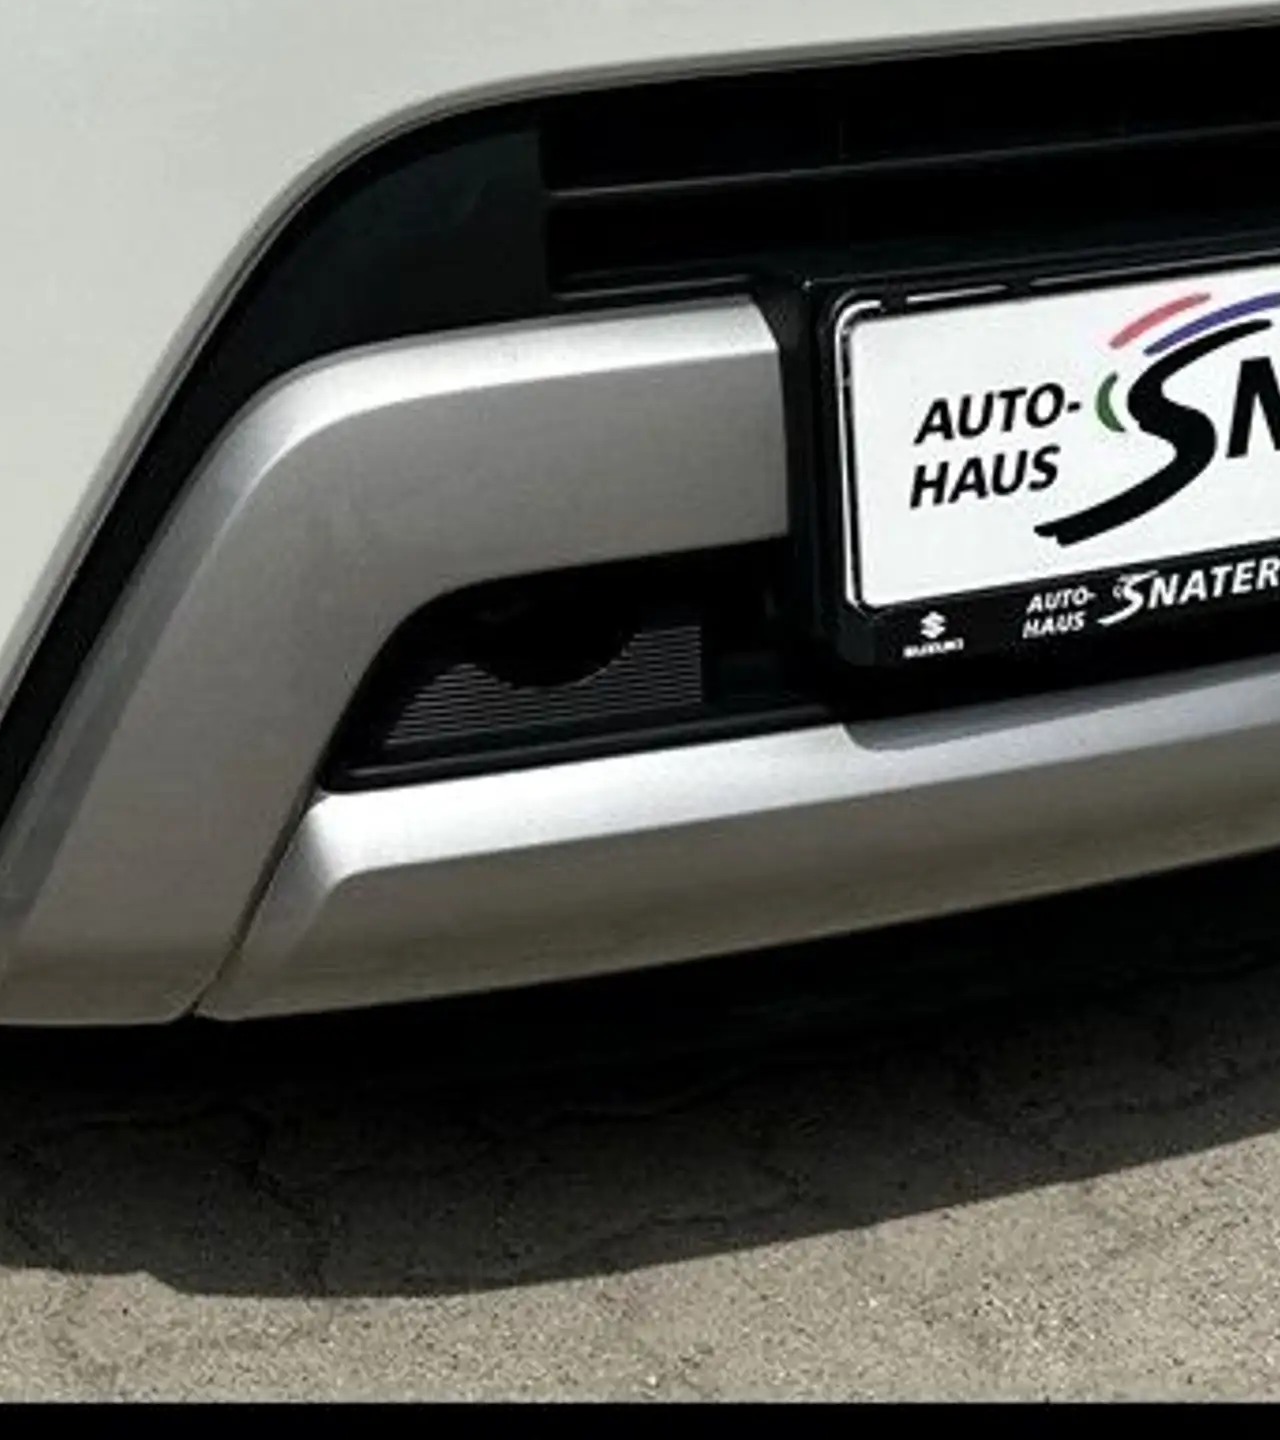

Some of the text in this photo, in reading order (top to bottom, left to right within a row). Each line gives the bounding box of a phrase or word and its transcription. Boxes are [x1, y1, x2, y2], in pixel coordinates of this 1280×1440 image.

[913, 382, 1081, 445] AUTO-
[909, 444, 1061, 509] HAUS
[1026, 585, 1096, 614] AUTO-
[1022, 611, 1086, 639] HAUS
